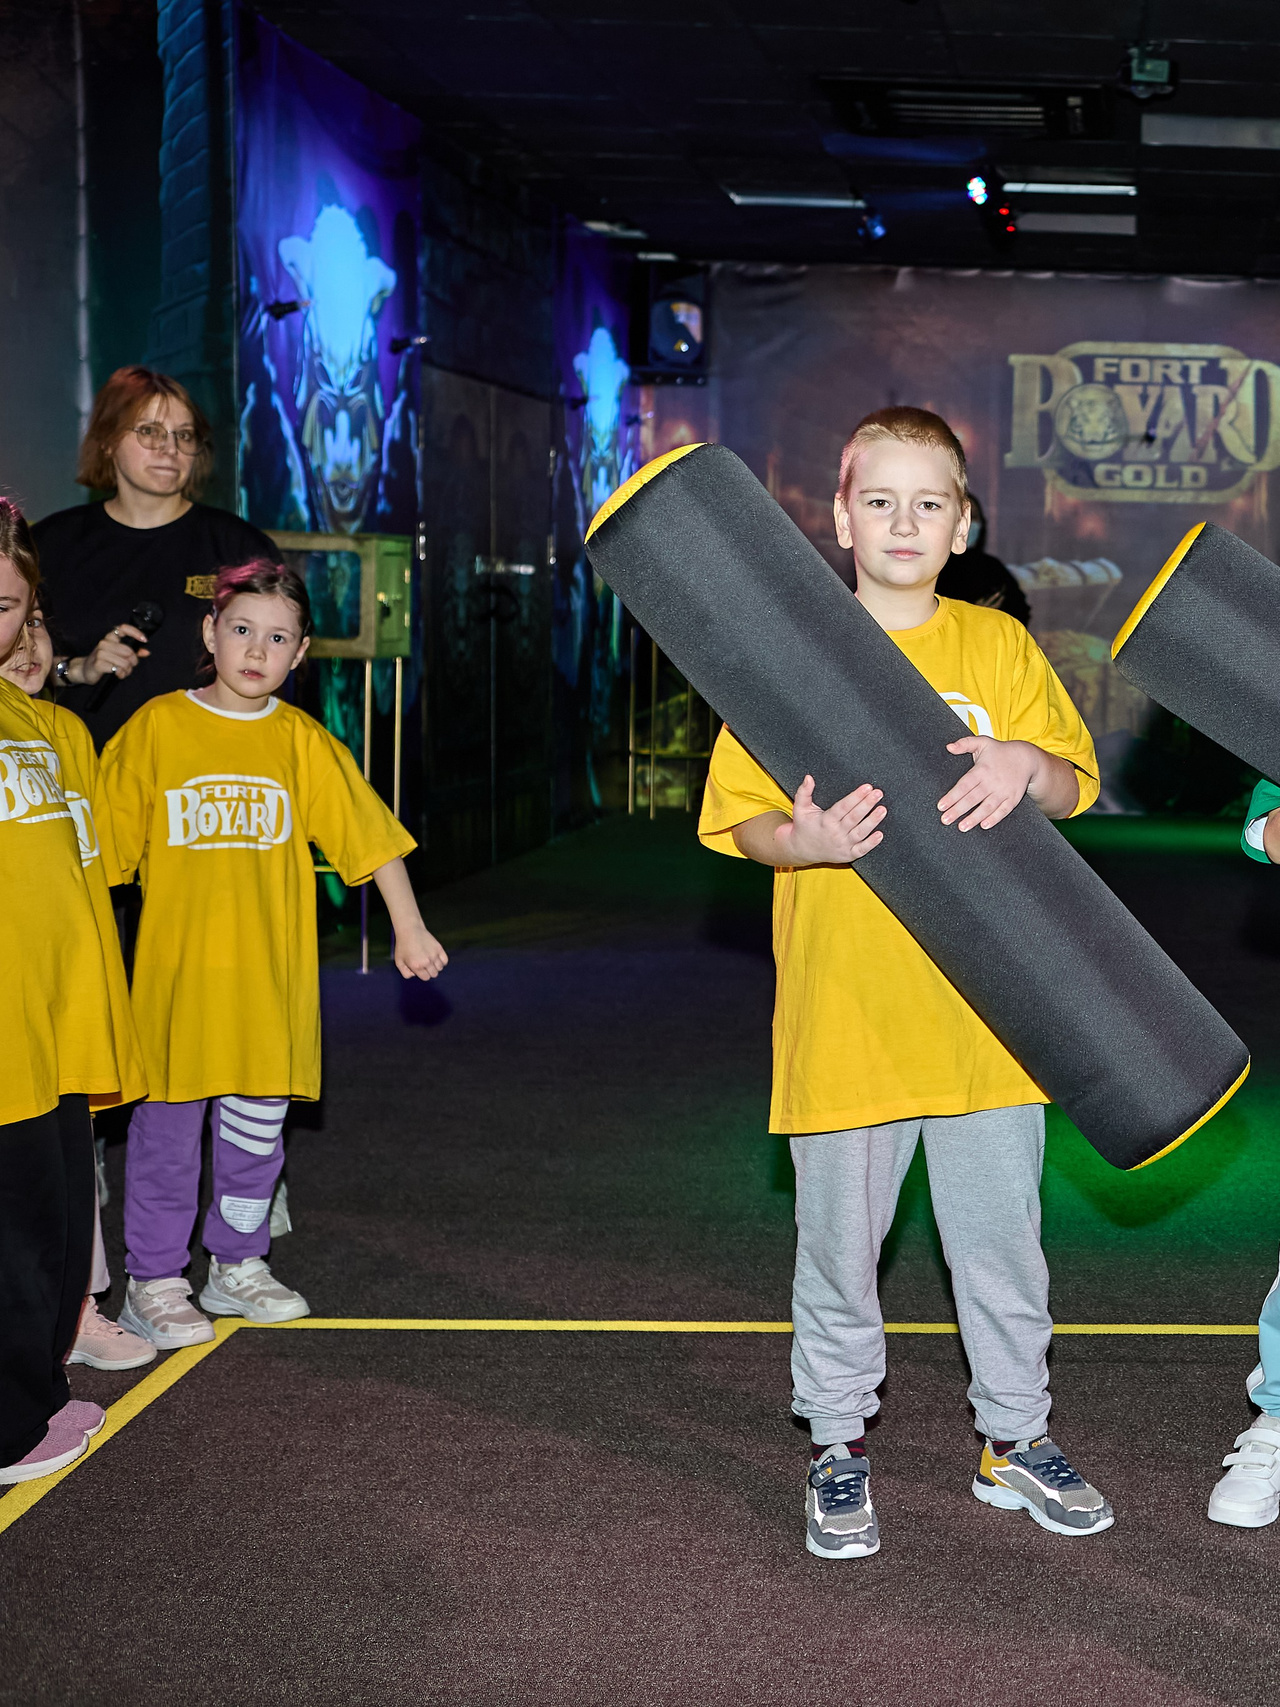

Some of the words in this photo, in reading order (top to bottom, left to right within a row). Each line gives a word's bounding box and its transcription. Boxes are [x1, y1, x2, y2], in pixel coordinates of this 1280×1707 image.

[1093, 357, 1208, 384] FORT
[1093, 464, 1208, 488] GOLD
[201, 785, 260, 799] FORT
[165, 787, 293, 846] BOYARD
